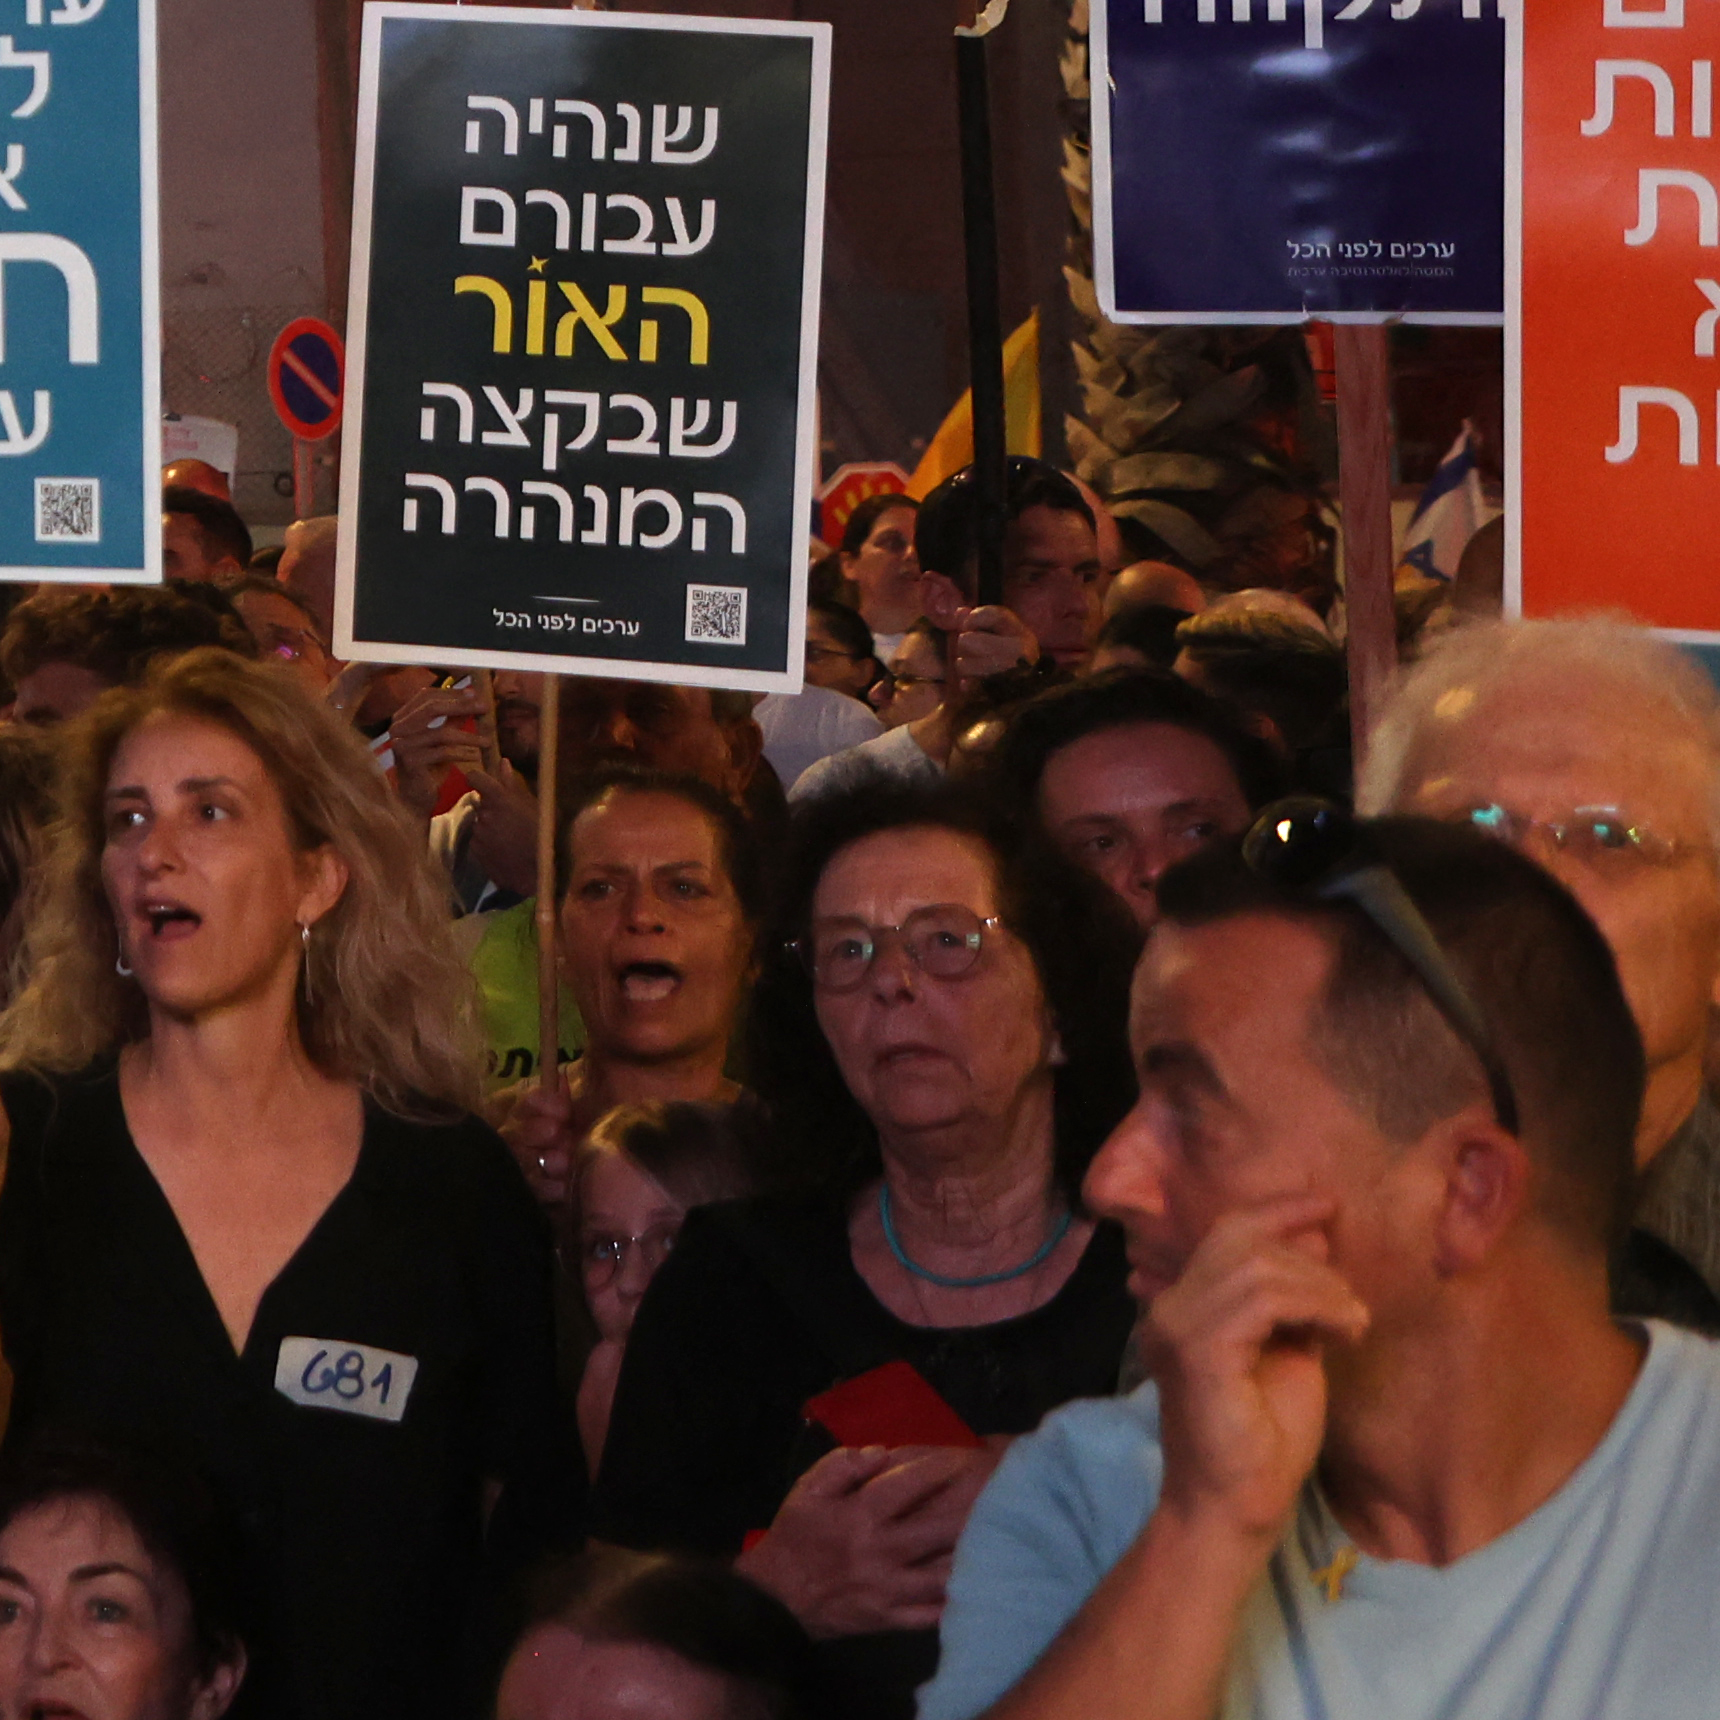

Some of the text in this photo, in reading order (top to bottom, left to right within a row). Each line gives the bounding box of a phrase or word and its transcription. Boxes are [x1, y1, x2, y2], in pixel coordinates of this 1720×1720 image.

[464, 94, 720, 165] שנהיה
[459, 184, 717, 256] עבורם
[1286, 239, 1456, 259] ערכים לפני הכל
[419, 381, 739, 471] שבקצה
[402, 472, 747, 555] המנהרה
[492, 607, 640, 635] ערכים לפני הכל
[301, 1349, 392, 1404] 681
